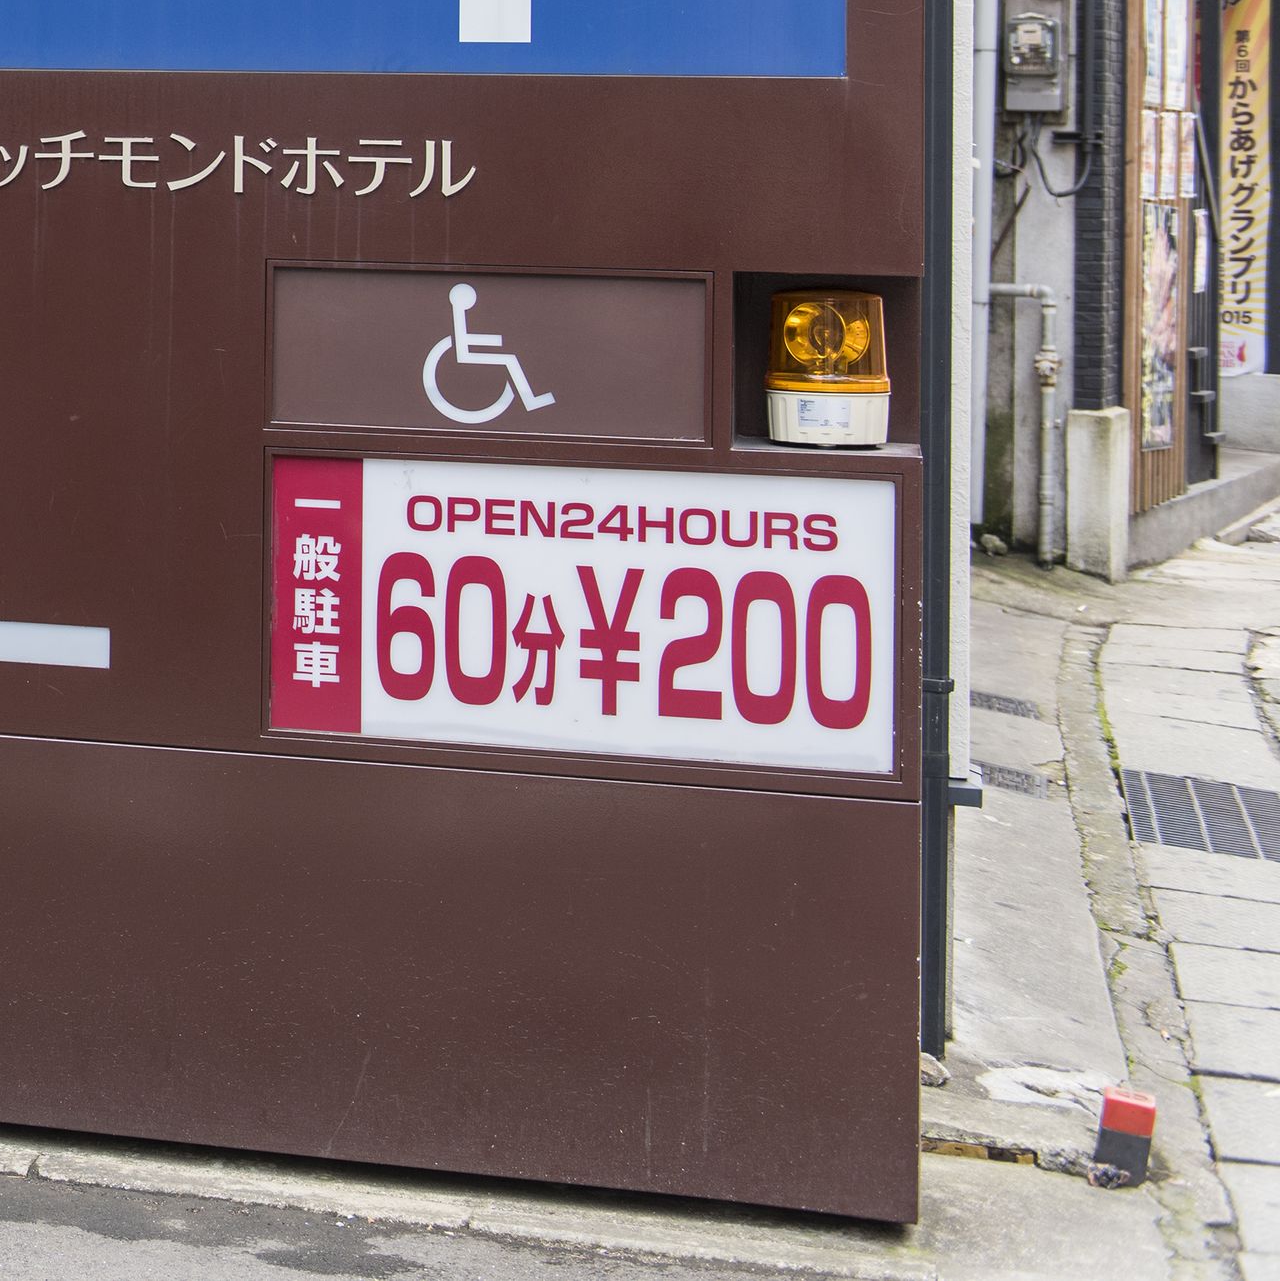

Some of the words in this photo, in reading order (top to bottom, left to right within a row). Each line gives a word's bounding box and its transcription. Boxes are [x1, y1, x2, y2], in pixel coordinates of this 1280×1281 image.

[1221, 311, 1252, 324] 015
[291, 494, 343, 689] 一般駐車
